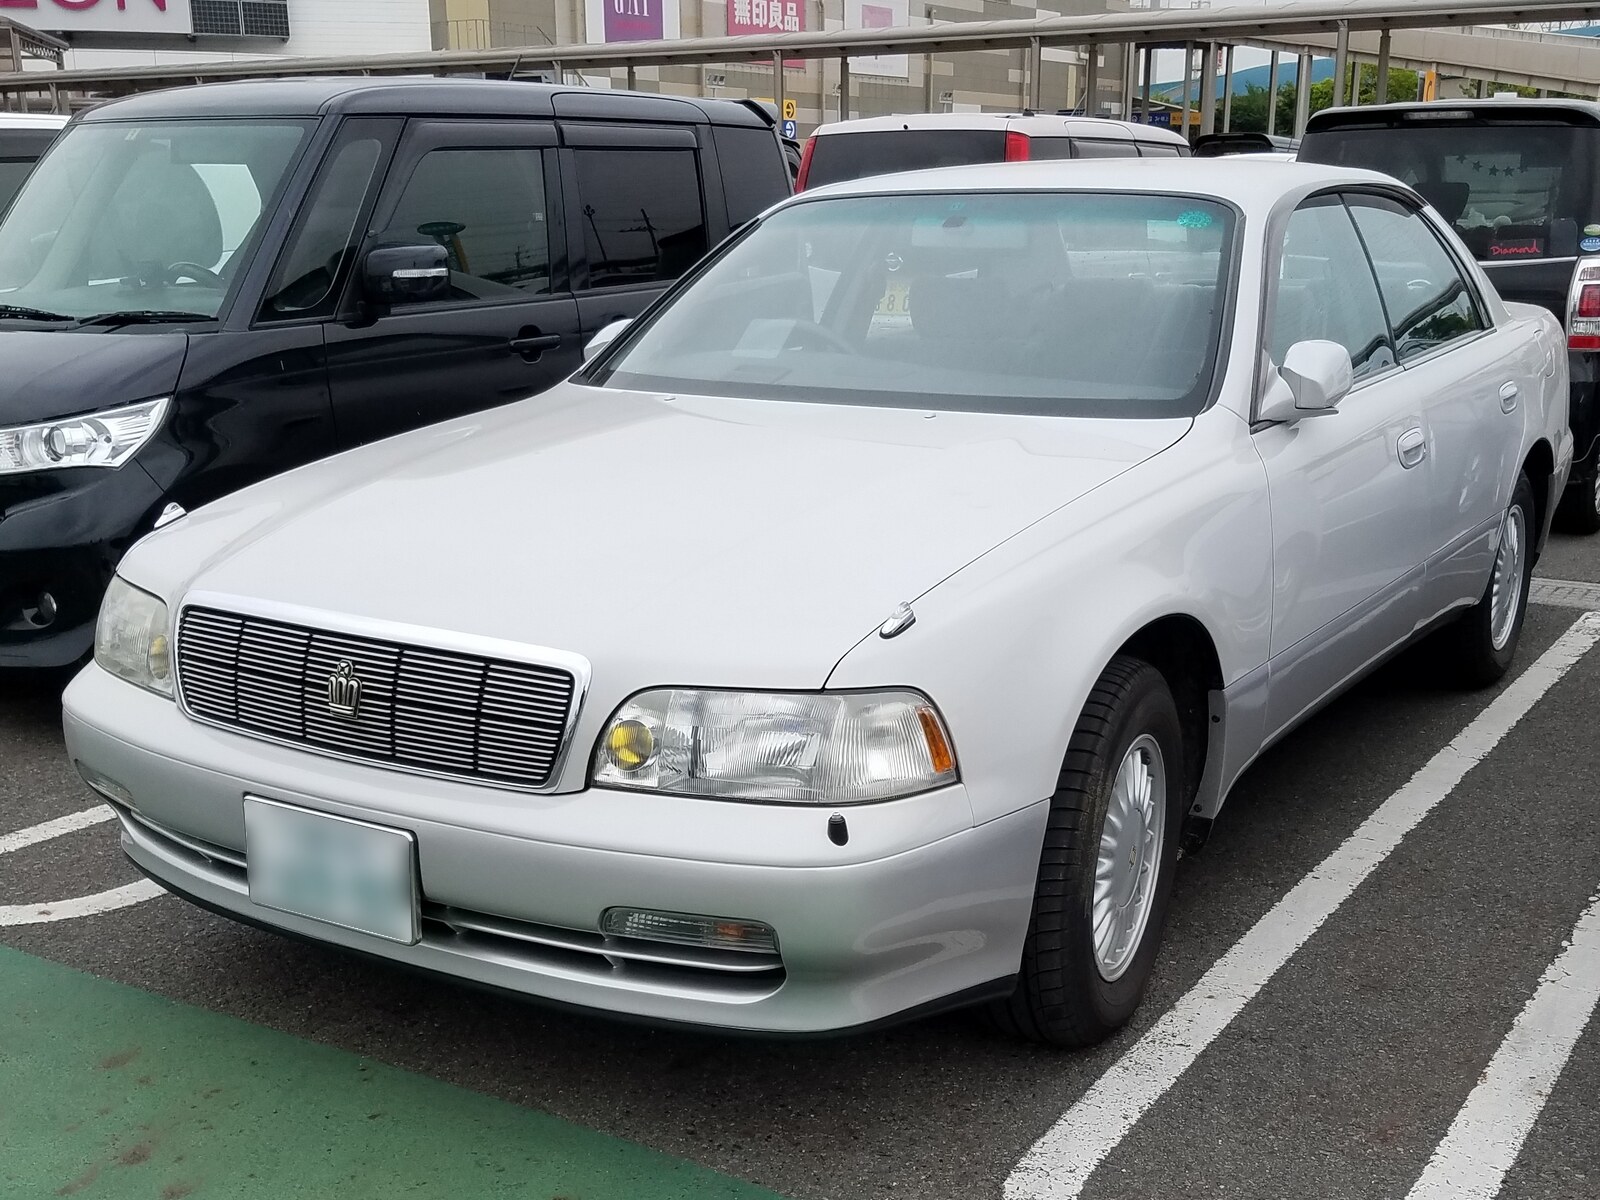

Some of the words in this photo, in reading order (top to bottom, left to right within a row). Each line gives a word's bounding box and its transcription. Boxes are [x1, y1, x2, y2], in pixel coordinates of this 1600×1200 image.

[734, 0, 799, 31] 無印良品
[1490, 240, 1540, 255] Diamond
